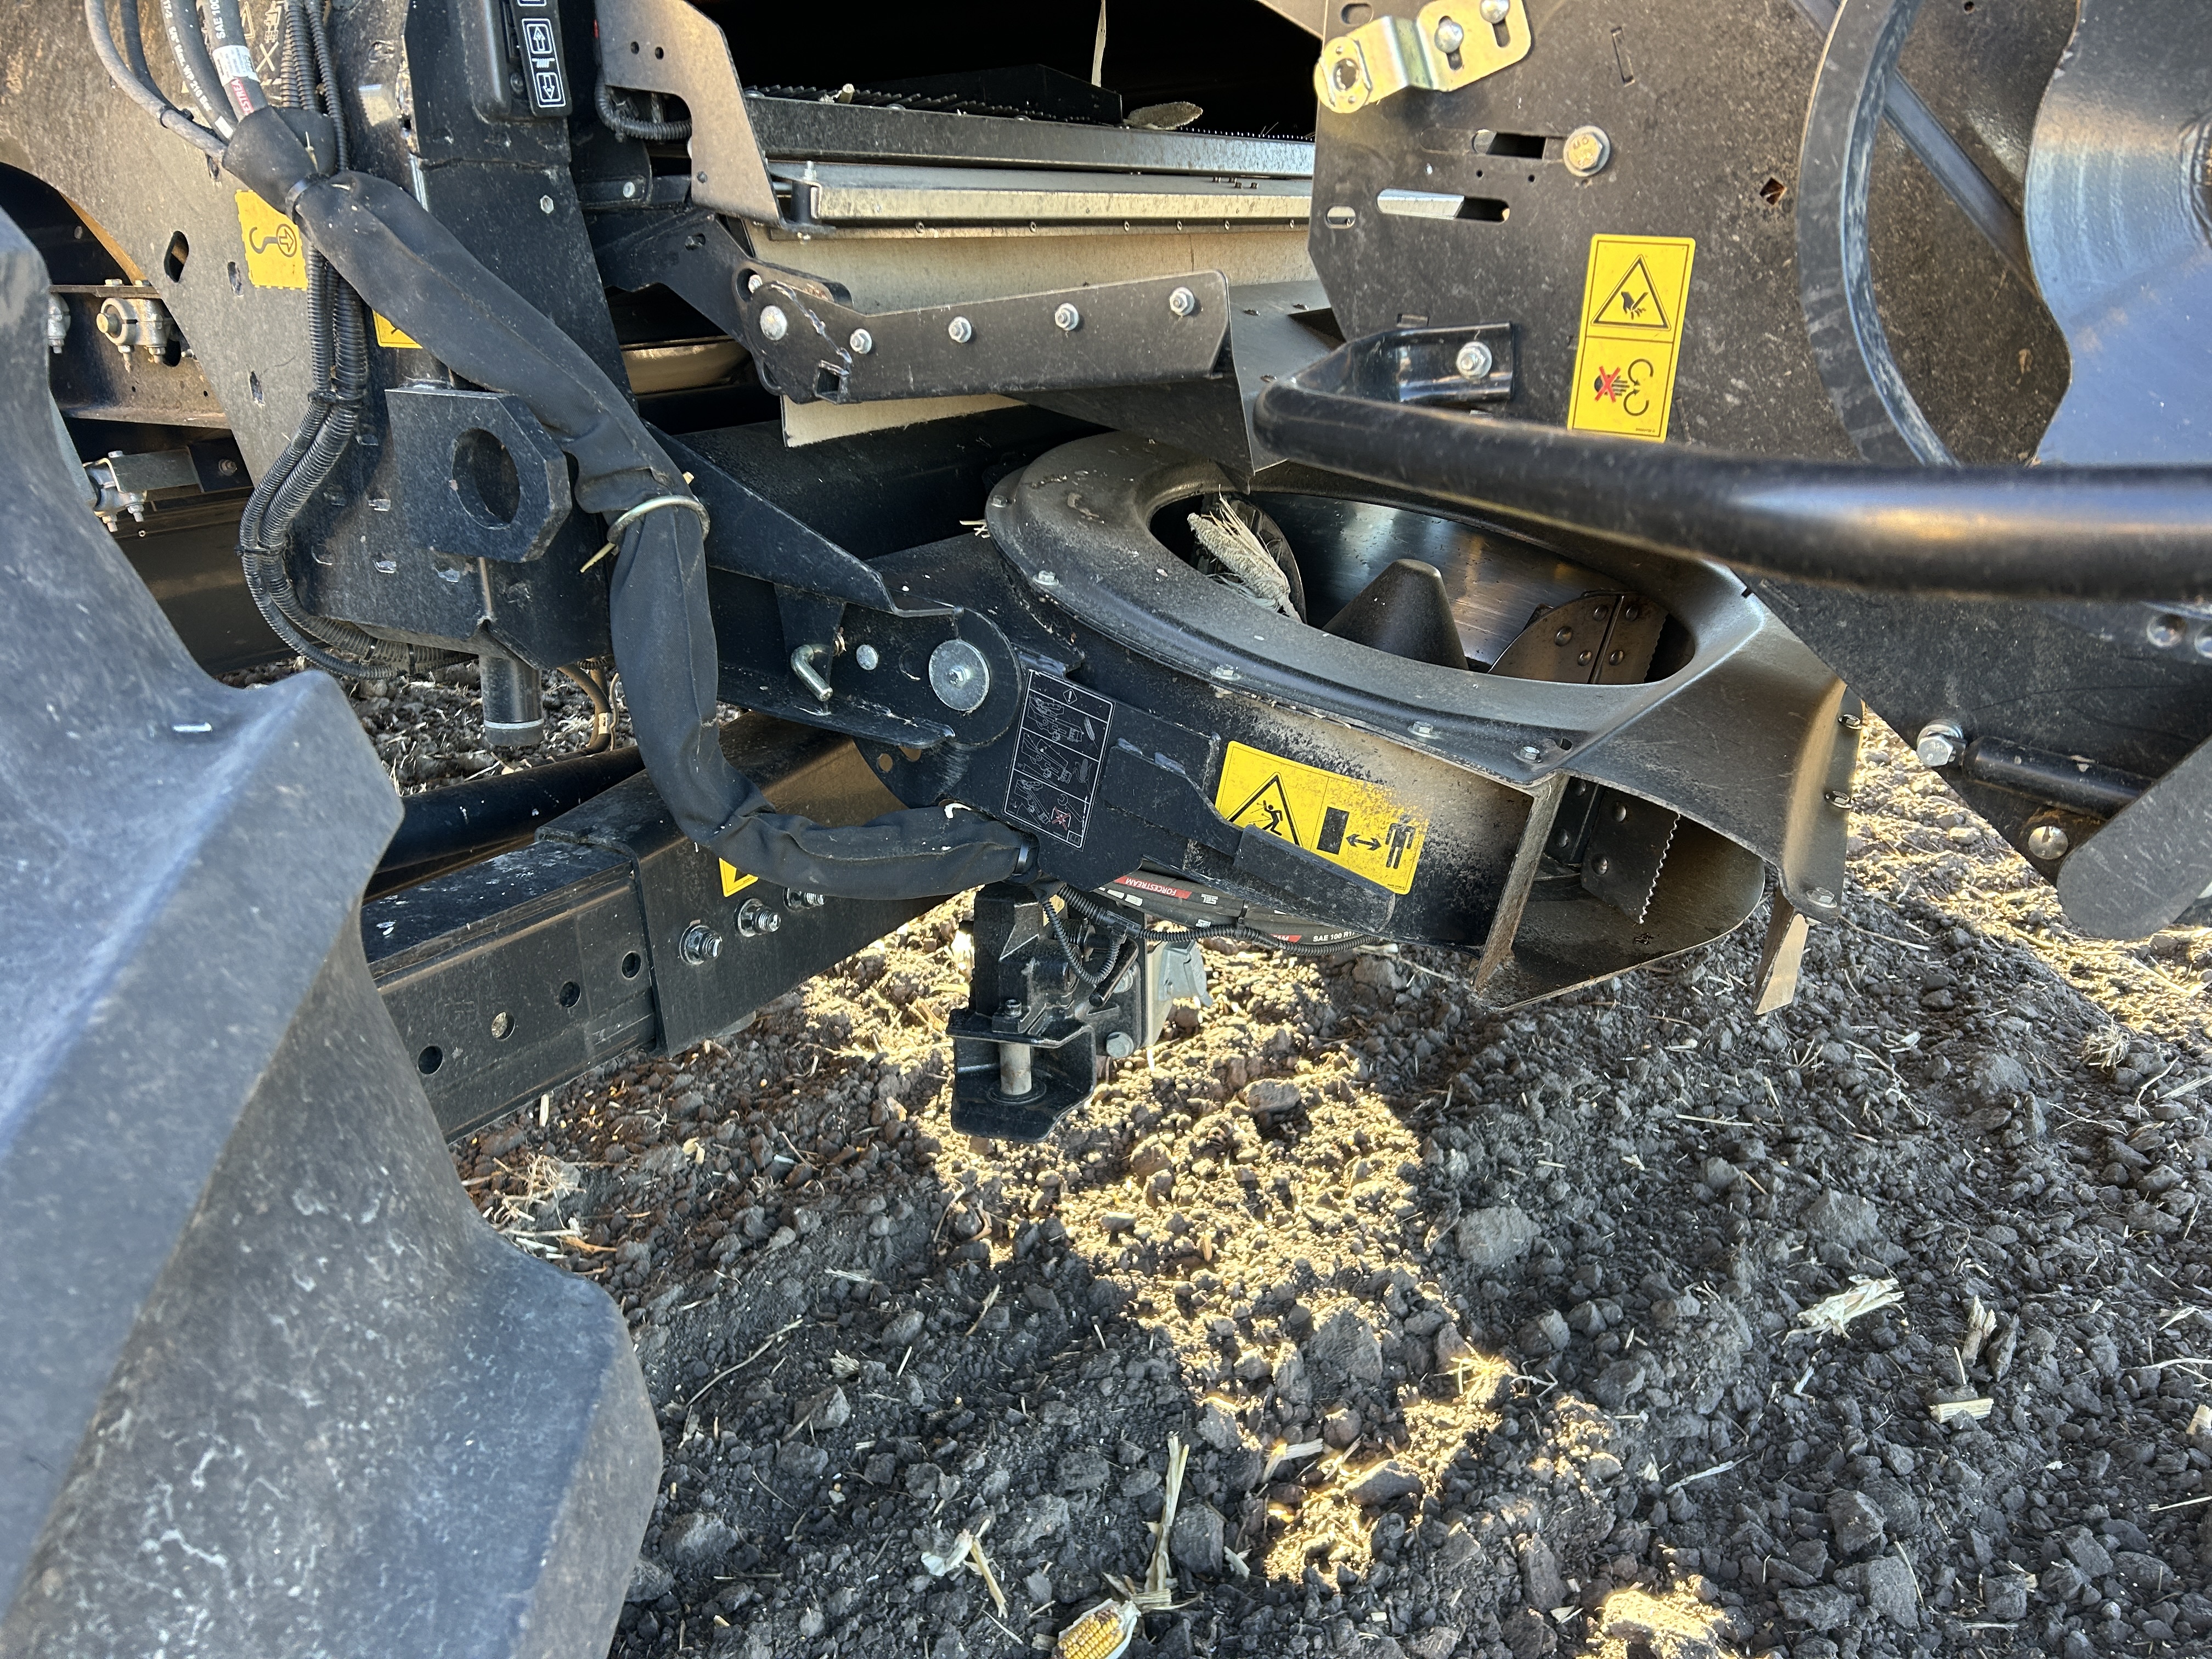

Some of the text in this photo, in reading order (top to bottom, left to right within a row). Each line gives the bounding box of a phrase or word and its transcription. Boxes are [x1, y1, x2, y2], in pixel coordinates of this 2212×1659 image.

[213, 16, 226, 40] SAE
[183, 64, 195, 81] WP
[190, 80, 203, 98] 210
[199, 95, 212, 112] Bar
[1125, 877, 1218, 905] FORCESTREAM SEL
